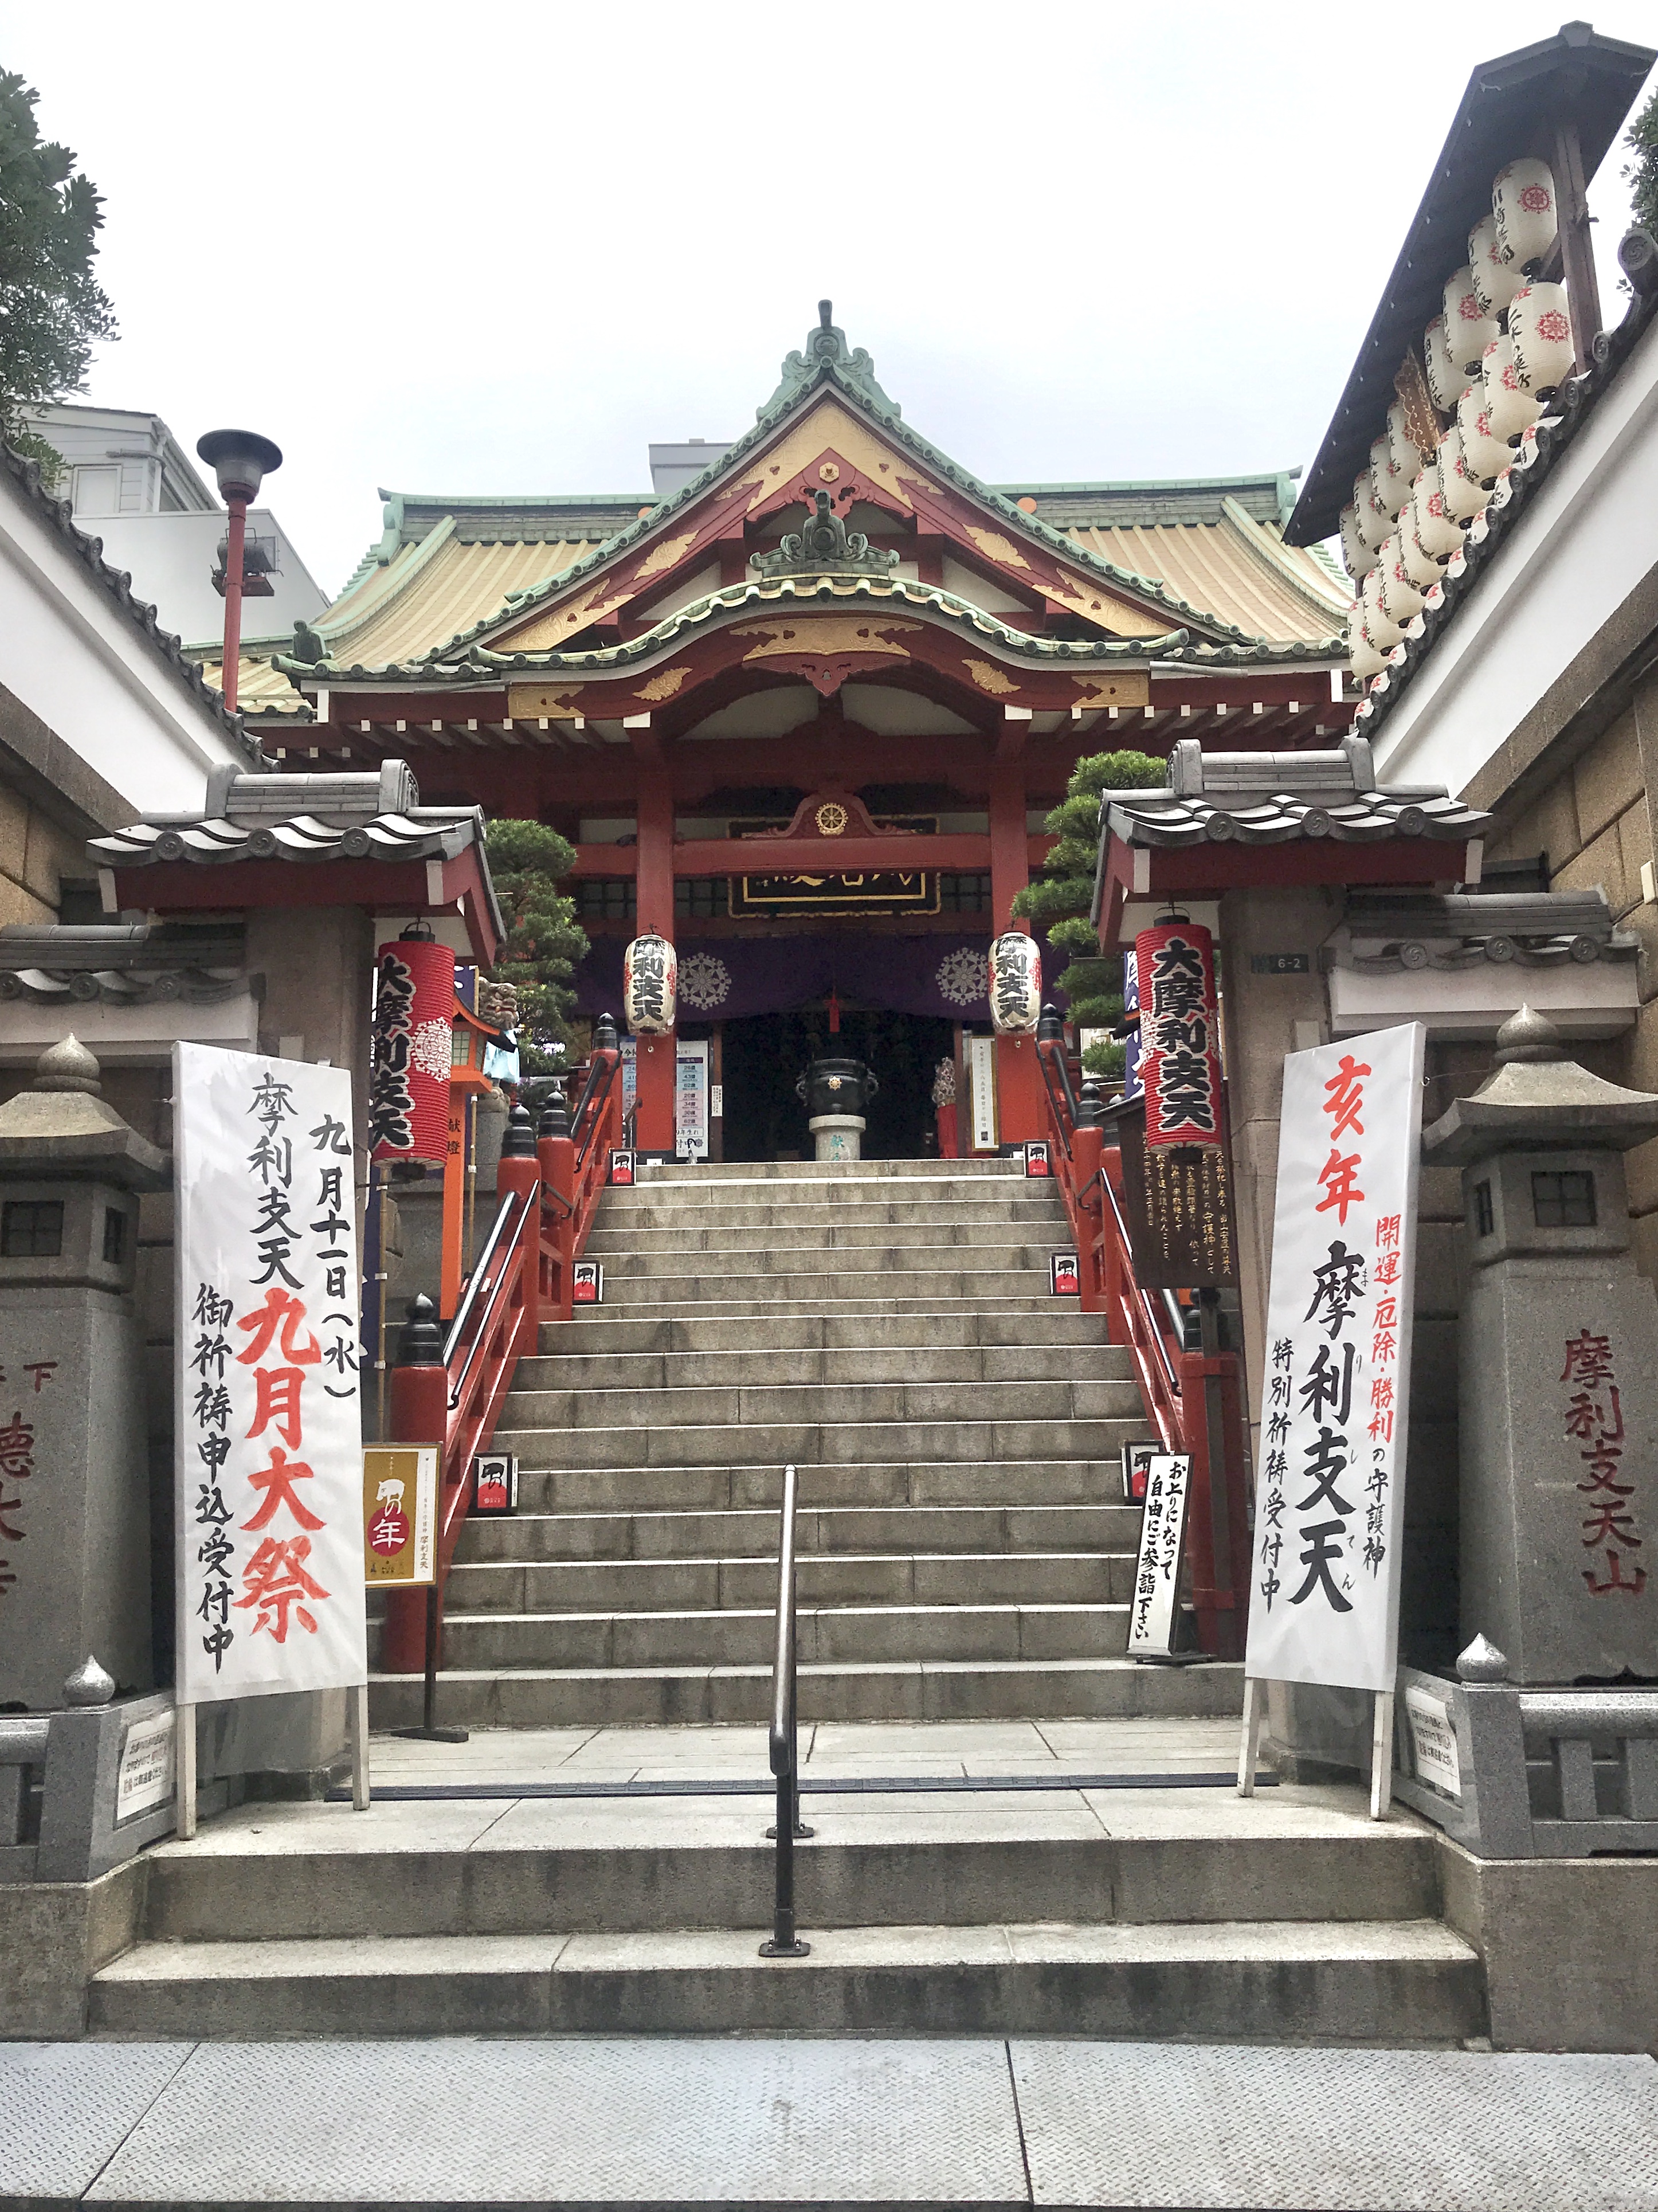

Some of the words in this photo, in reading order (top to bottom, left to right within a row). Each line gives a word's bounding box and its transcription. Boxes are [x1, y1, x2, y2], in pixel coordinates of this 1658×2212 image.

[371, 953, 415, 1150] 大摩利支天
[633, 939, 665, 1022] 摩利支天
[995, 935, 1029, 1020] 摩利支天
[1154, 938, 1214, 1130] 大摩利支天
[1277, 958, 1301, 969] 6-2
[309, 1114, 360, 1399] 九月十一日（水）
[187, 1282, 234, 1675] 御祈祷申込受付中
[1135, 1474, 1163, 1640] 自由にご参詣下さい
[1160, 1462, 1186, 1580] お上りになって
[1260, 1336, 1295, 1614] 特別祈祷受付中
[1559, 1328, 1648, 1598] 摩利支天山
